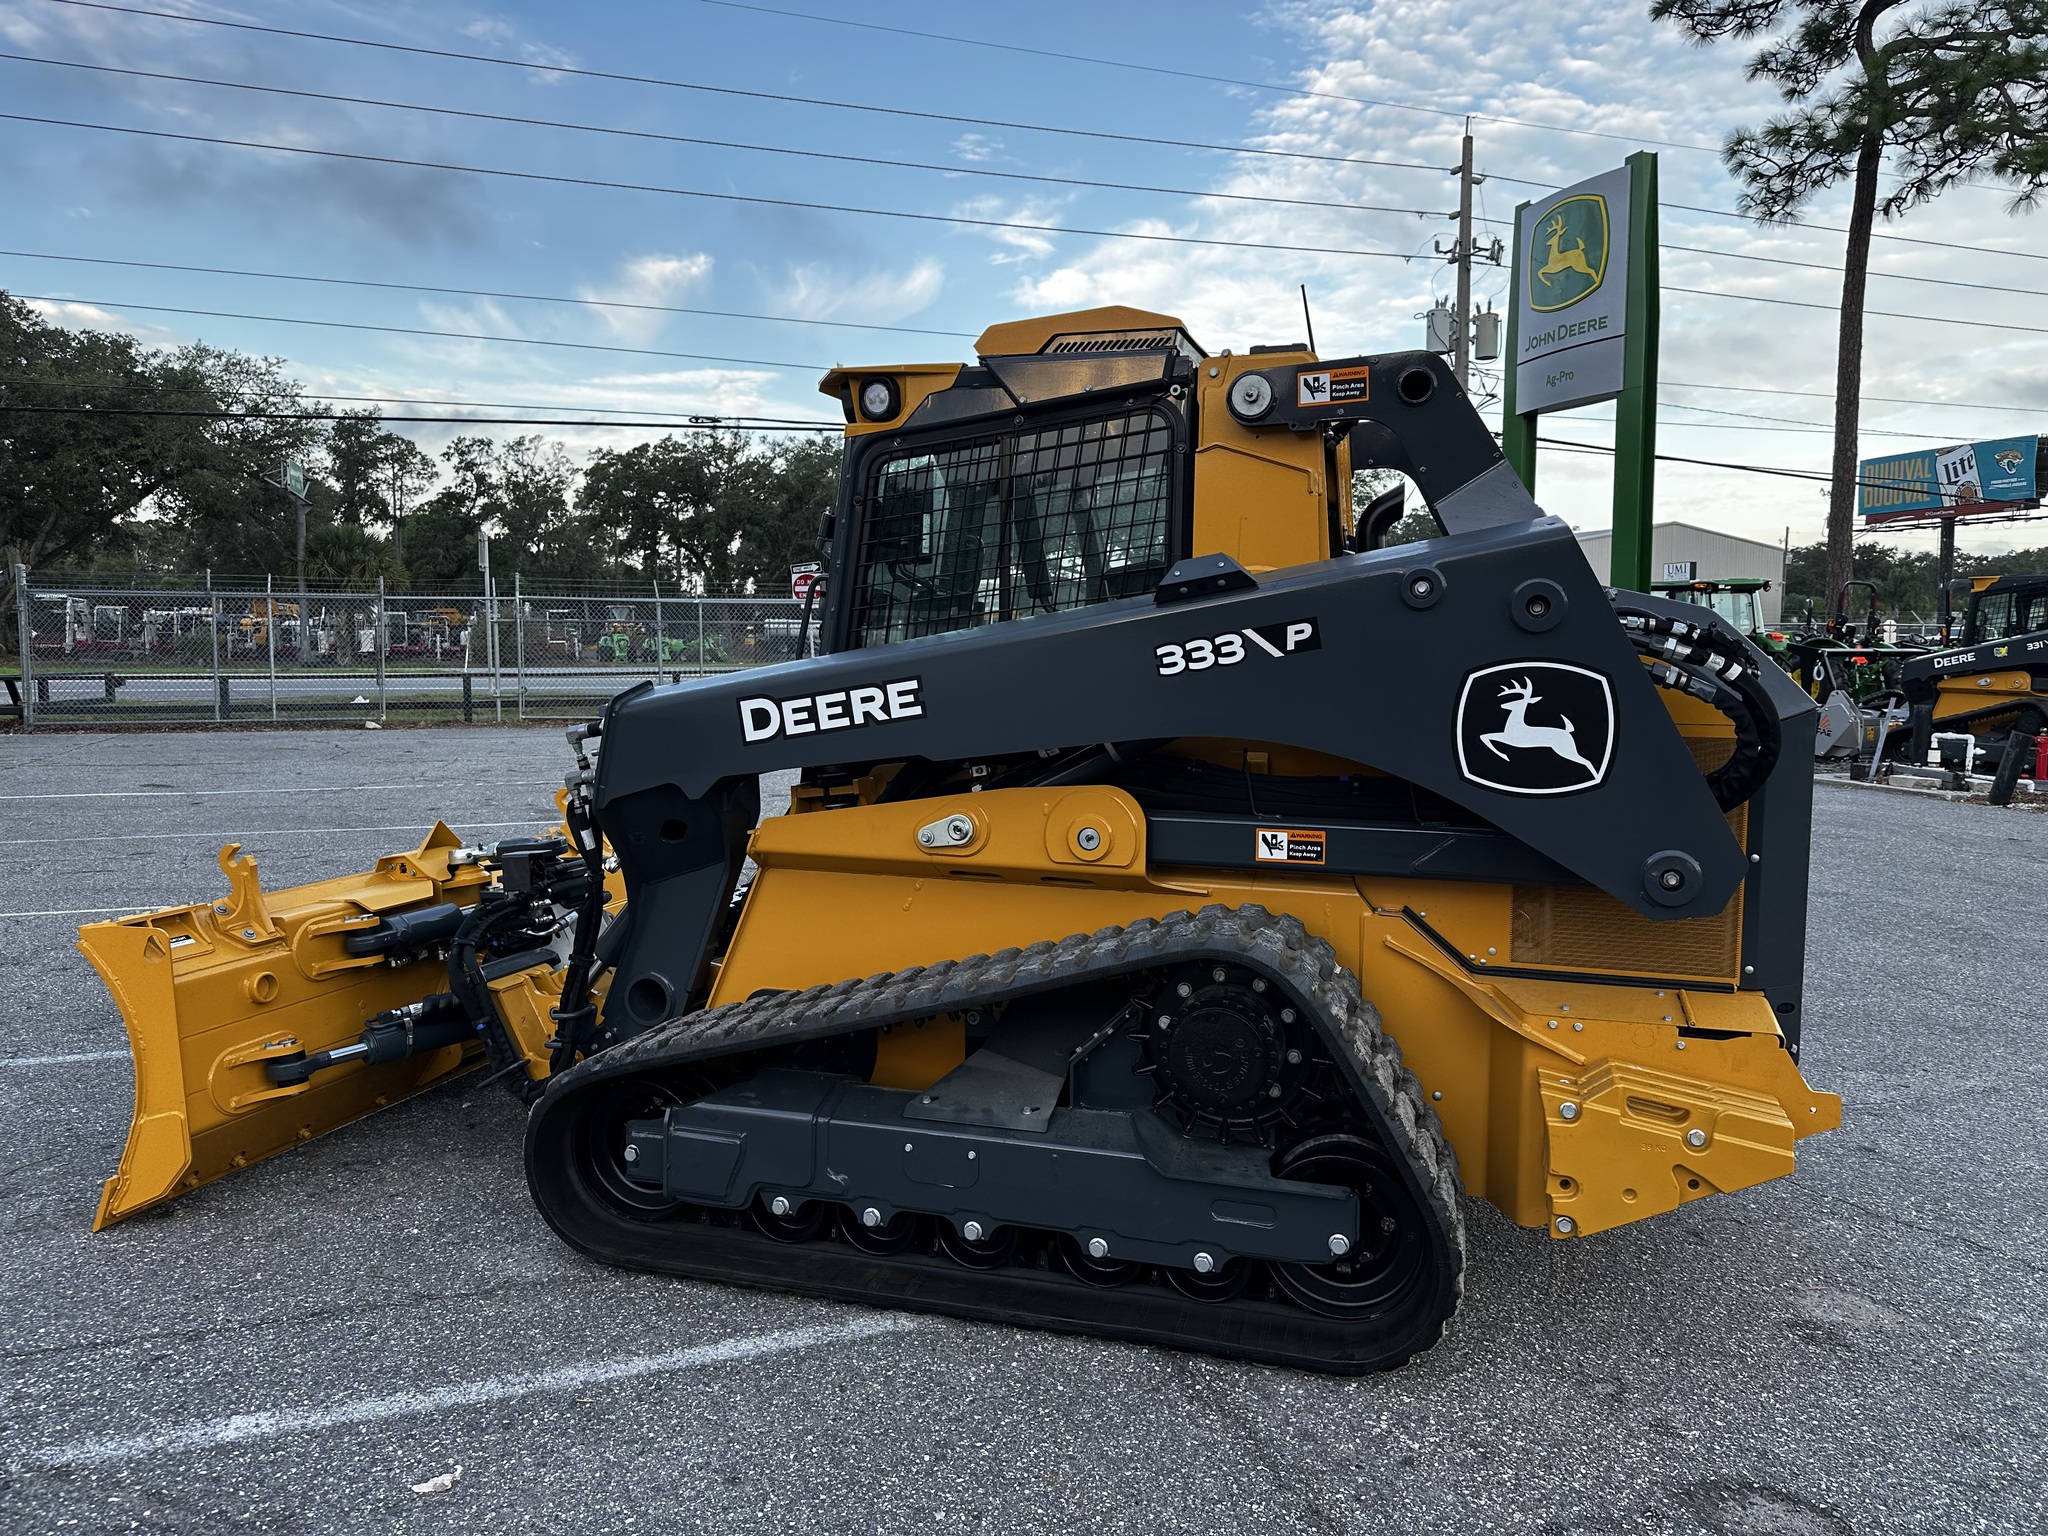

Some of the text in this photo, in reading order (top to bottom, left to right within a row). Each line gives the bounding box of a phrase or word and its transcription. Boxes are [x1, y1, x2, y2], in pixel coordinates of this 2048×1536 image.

[1525, 315, 1609, 353] JOHN DEERE
[1339, 370, 1365, 378] WARNING
[1546, 371, 1574, 387] Ag-Pro
[1350, 381, 1365, 389] Area
[1942, 453, 1975, 486] Lite
[1667, 563, 1687, 575] UMI
[1933, 652, 1976, 669] DEERE
[739, 679, 923, 742] DEERE
